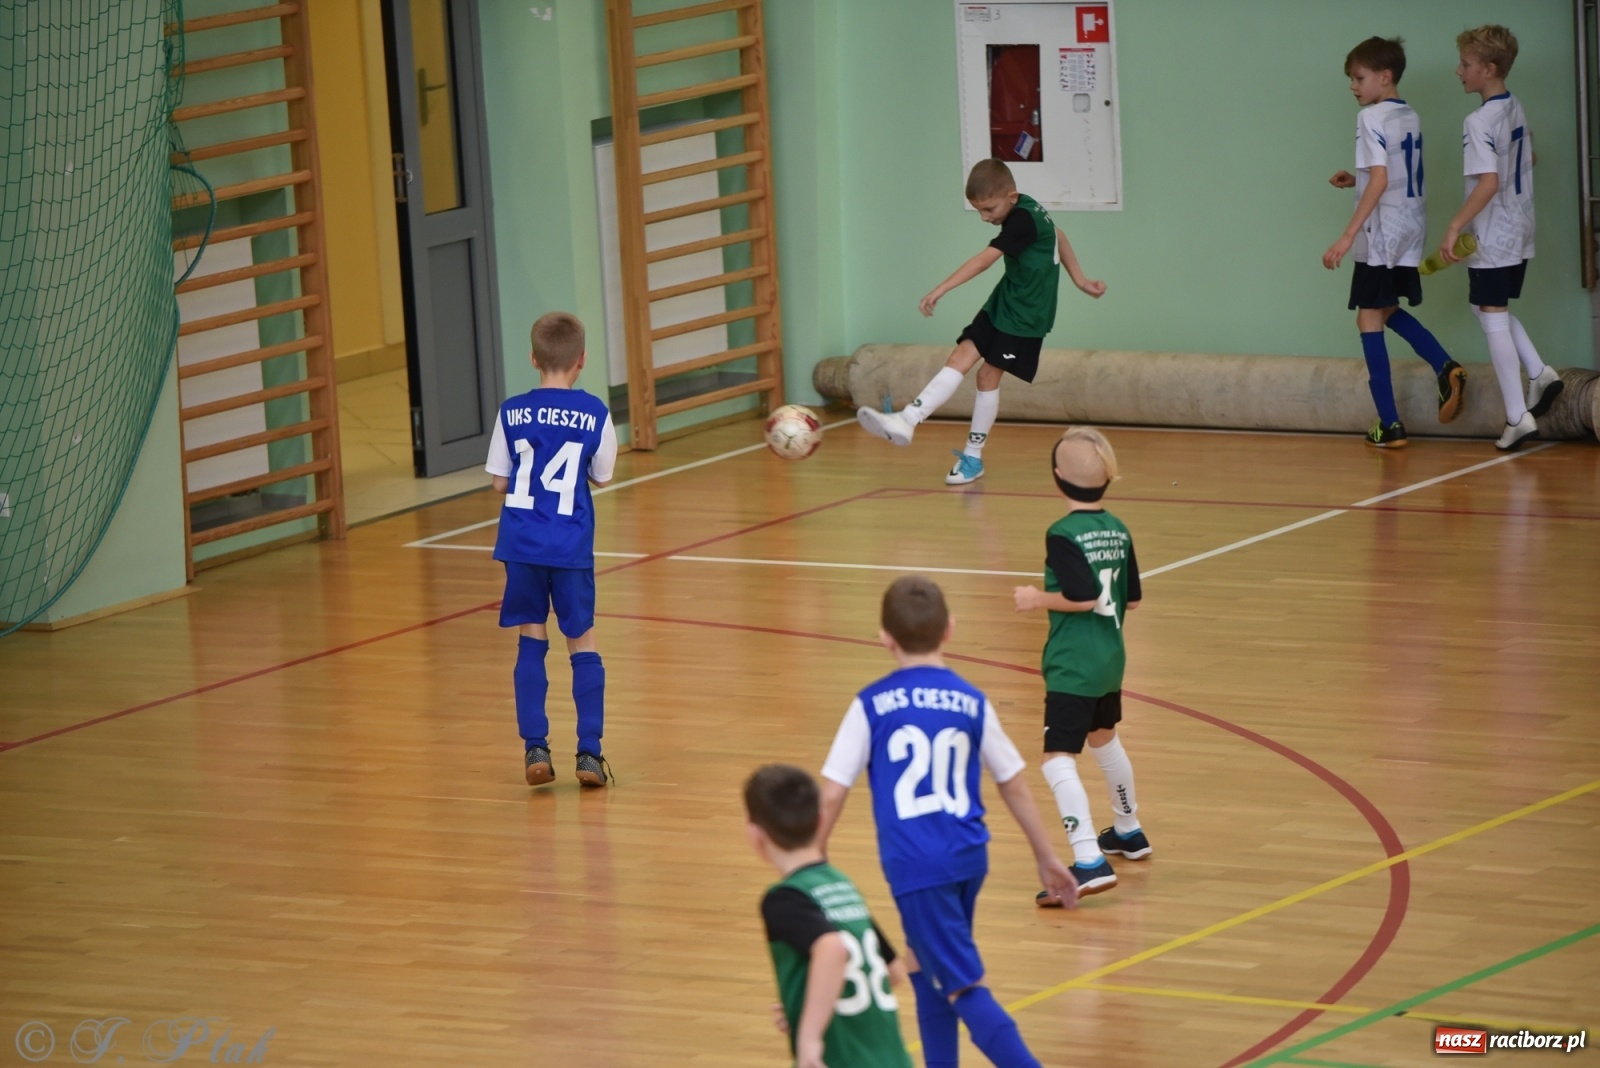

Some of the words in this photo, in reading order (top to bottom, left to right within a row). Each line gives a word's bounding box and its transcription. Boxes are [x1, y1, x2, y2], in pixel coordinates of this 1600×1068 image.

[1401, 132, 1424, 198] 11
[1511, 125, 1524, 195] 7
[506, 407, 533, 427] UKS
[537, 407, 597, 432] CIESZYN
[505, 438, 584, 516] 14
[872, 687, 909, 716] UKS
[911, 687, 979, 719] CIESZYN
[887, 724, 971, 820] 20
